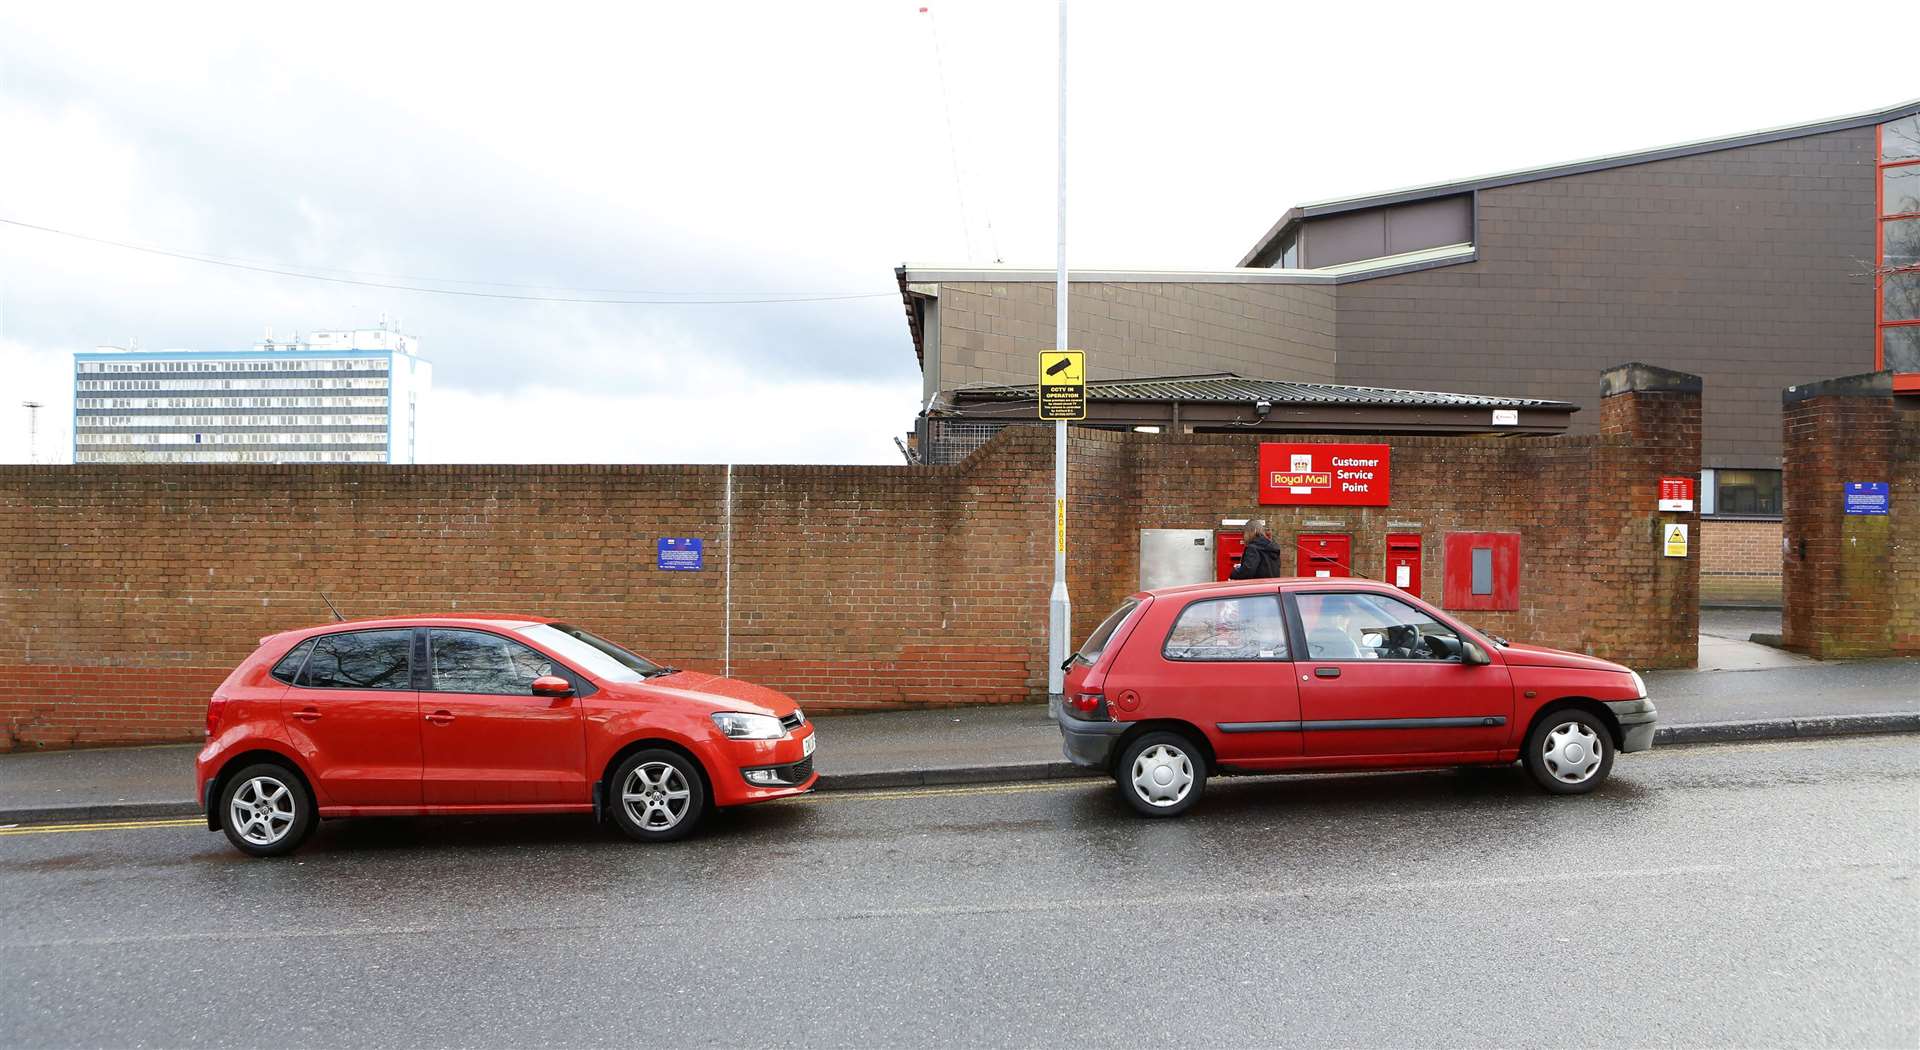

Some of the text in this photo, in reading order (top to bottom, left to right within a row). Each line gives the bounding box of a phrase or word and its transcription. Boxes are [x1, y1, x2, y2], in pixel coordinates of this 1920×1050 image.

[1332, 457, 1379, 467] Customer
[1274, 474, 1328, 485] Royal Mail
[1337, 469, 1373, 480] Service
[1342, 482, 1368, 492] Point
